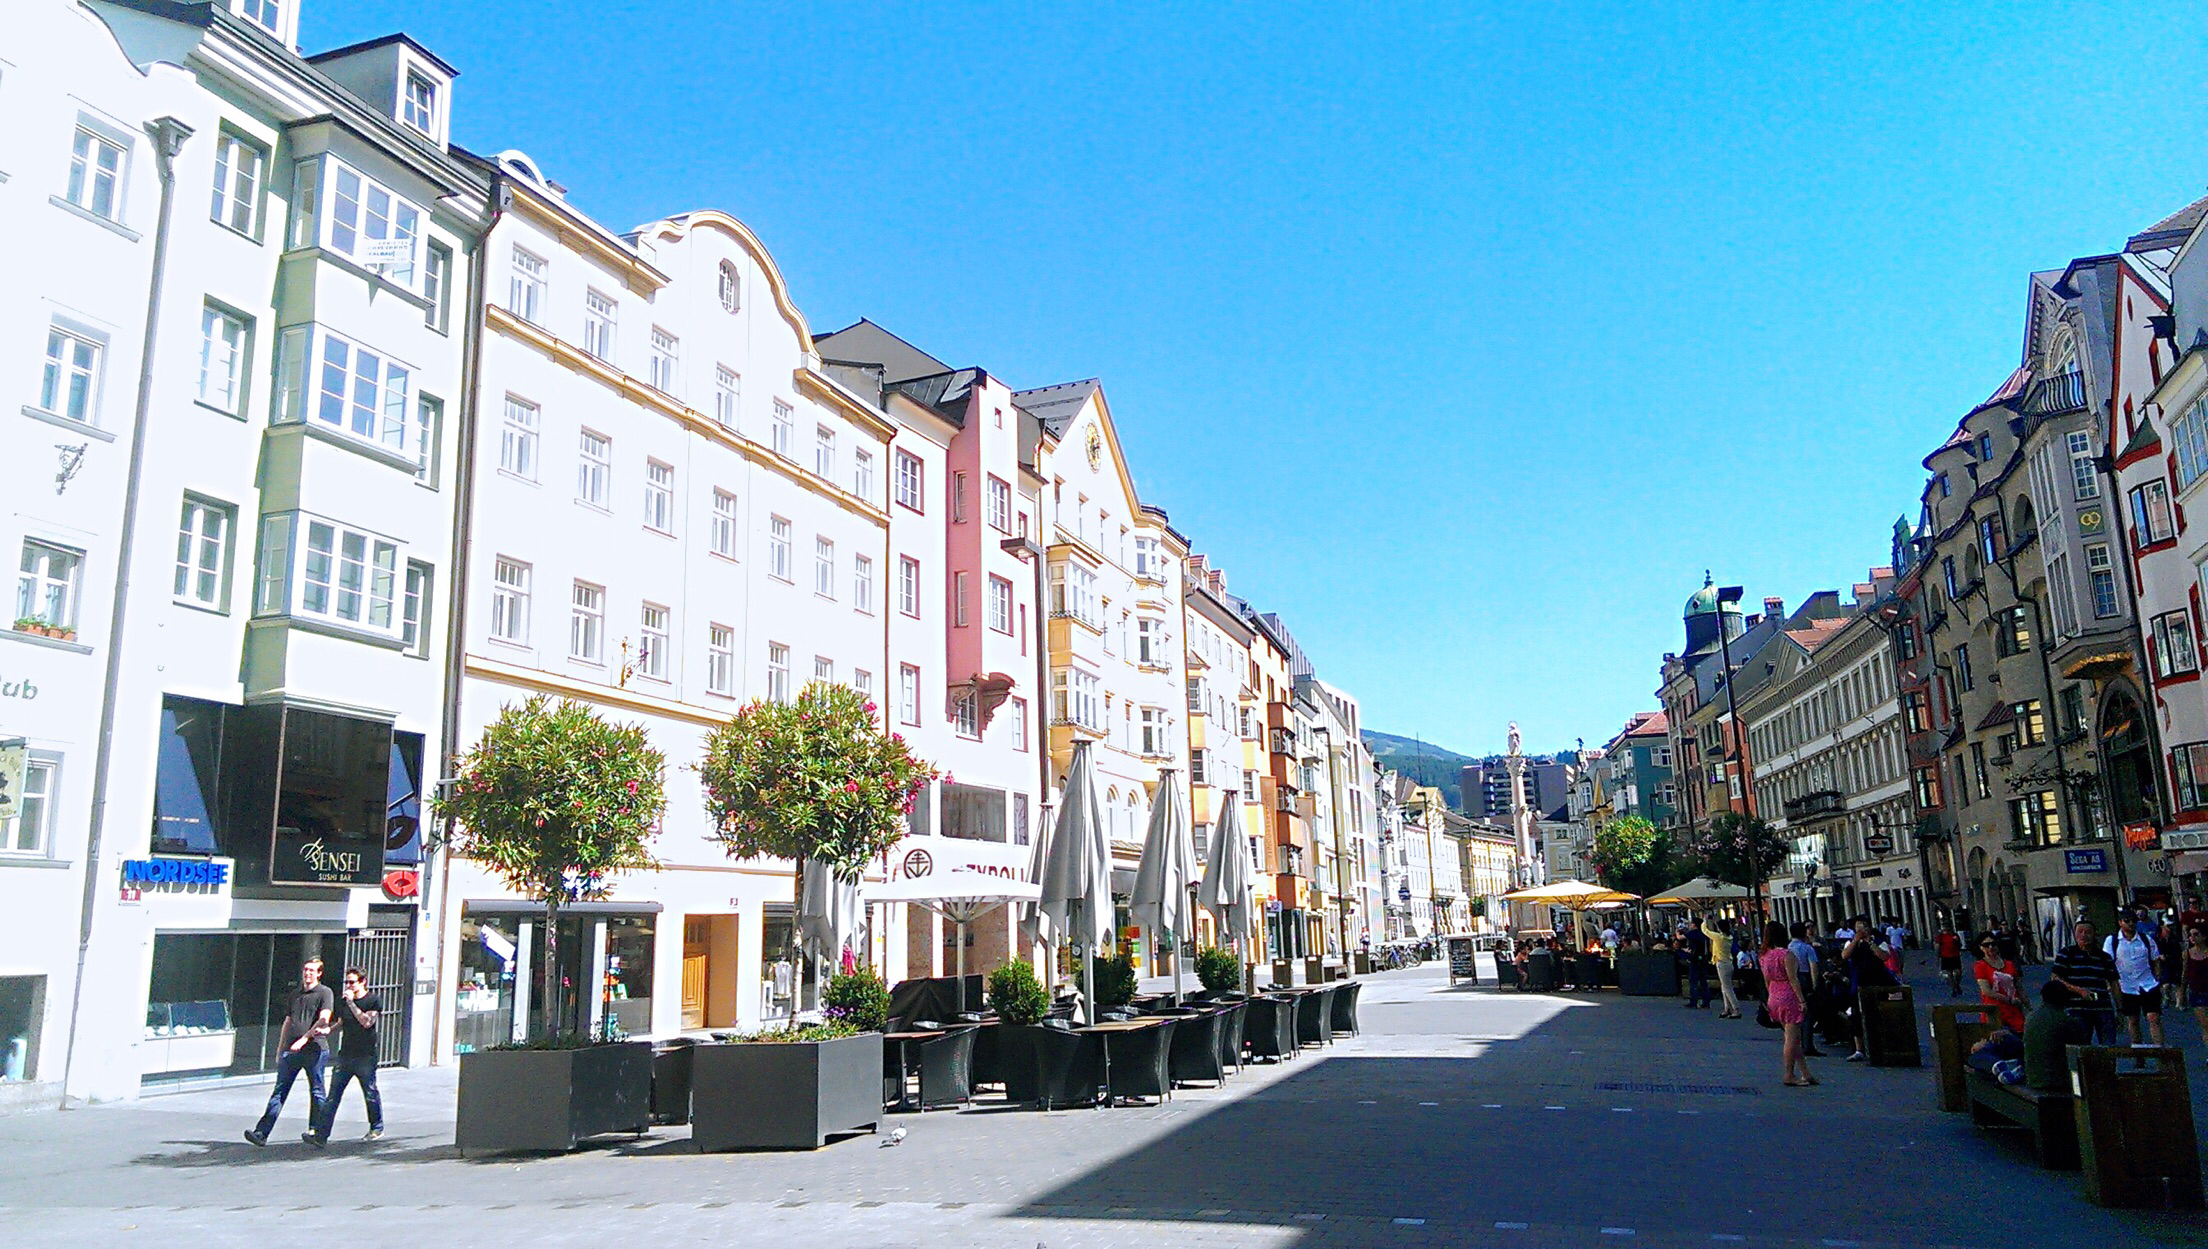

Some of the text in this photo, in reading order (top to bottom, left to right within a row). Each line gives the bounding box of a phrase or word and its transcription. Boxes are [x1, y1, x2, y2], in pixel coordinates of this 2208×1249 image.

[0, 674, 39, 700] ub
[126, 858, 229, 885] NORDSEE
[310, 851, 361, 873] SENSEI
[318, 873, 353, 882] SUSHI BAR
